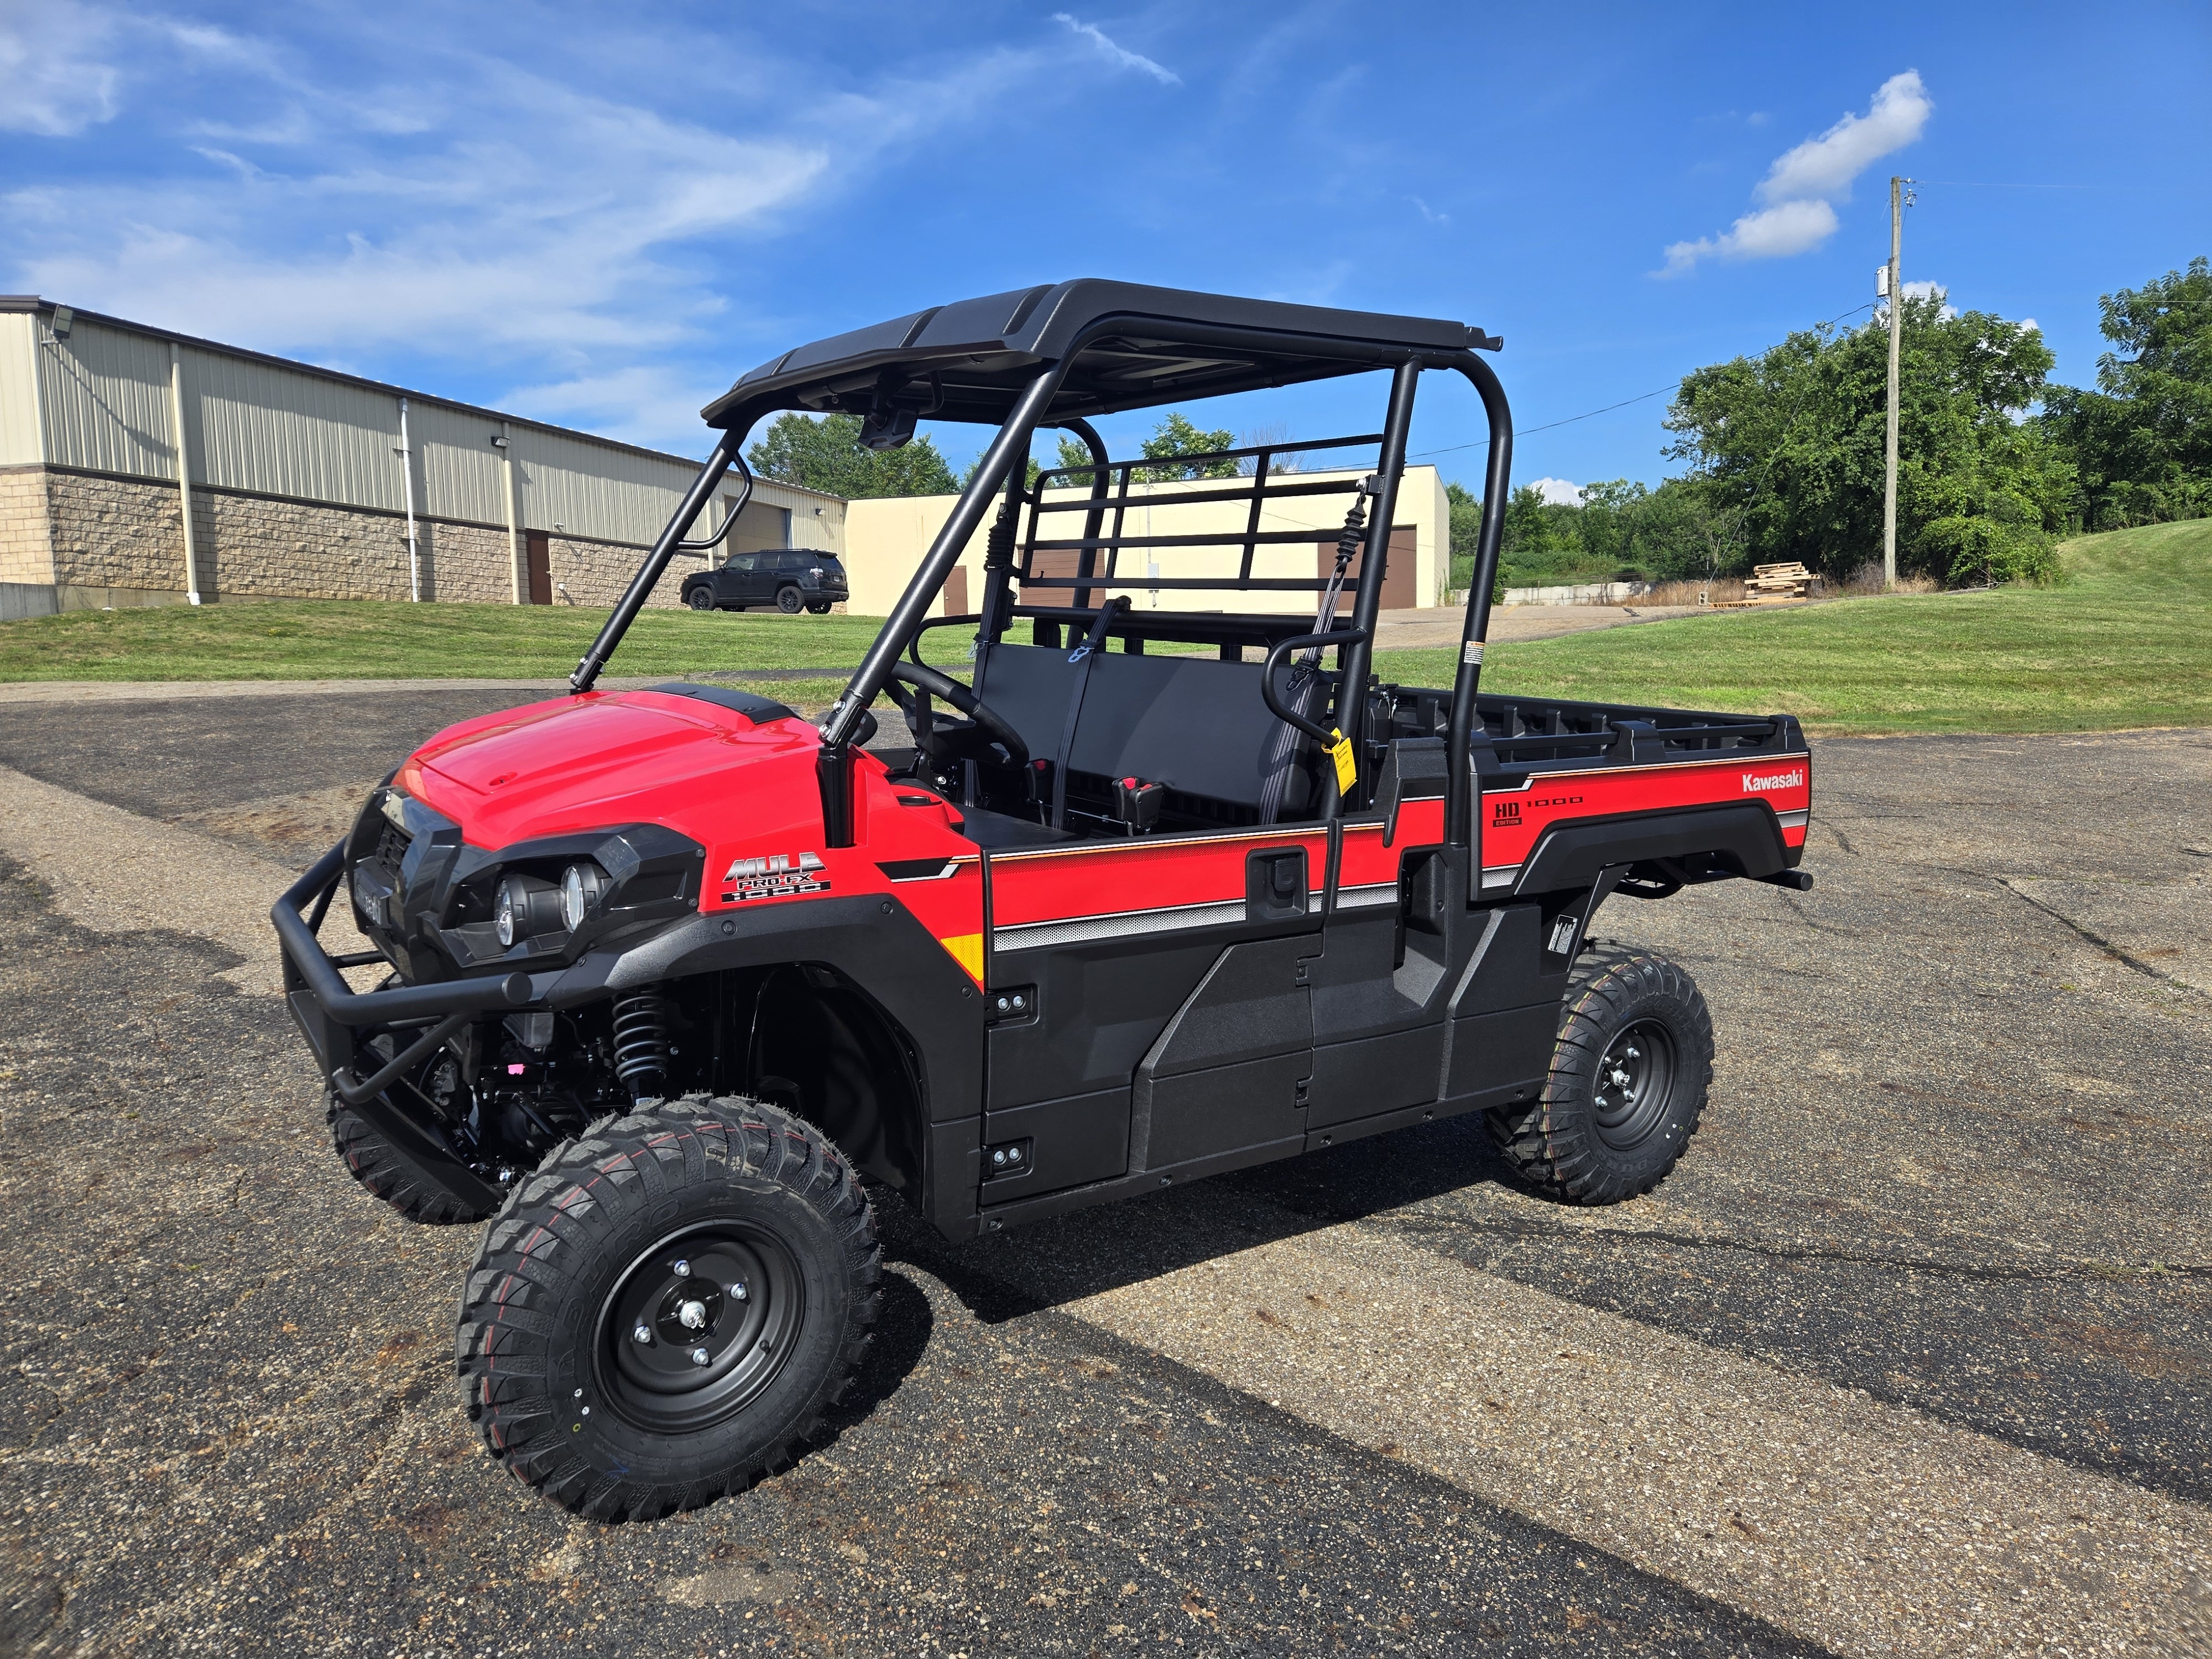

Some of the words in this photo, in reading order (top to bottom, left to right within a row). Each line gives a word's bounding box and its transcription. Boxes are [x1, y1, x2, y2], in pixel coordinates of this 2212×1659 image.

[1743, 769, 1803, 792] Kawasaki
[1495, 802, 1519, 818] HD
[1526, 796, 1583, 807] 1000
[722, 852, 828, 883] MULE
[737, 873, 815, 890] PRO-FX
[732, 883, 821, 900] 1000
